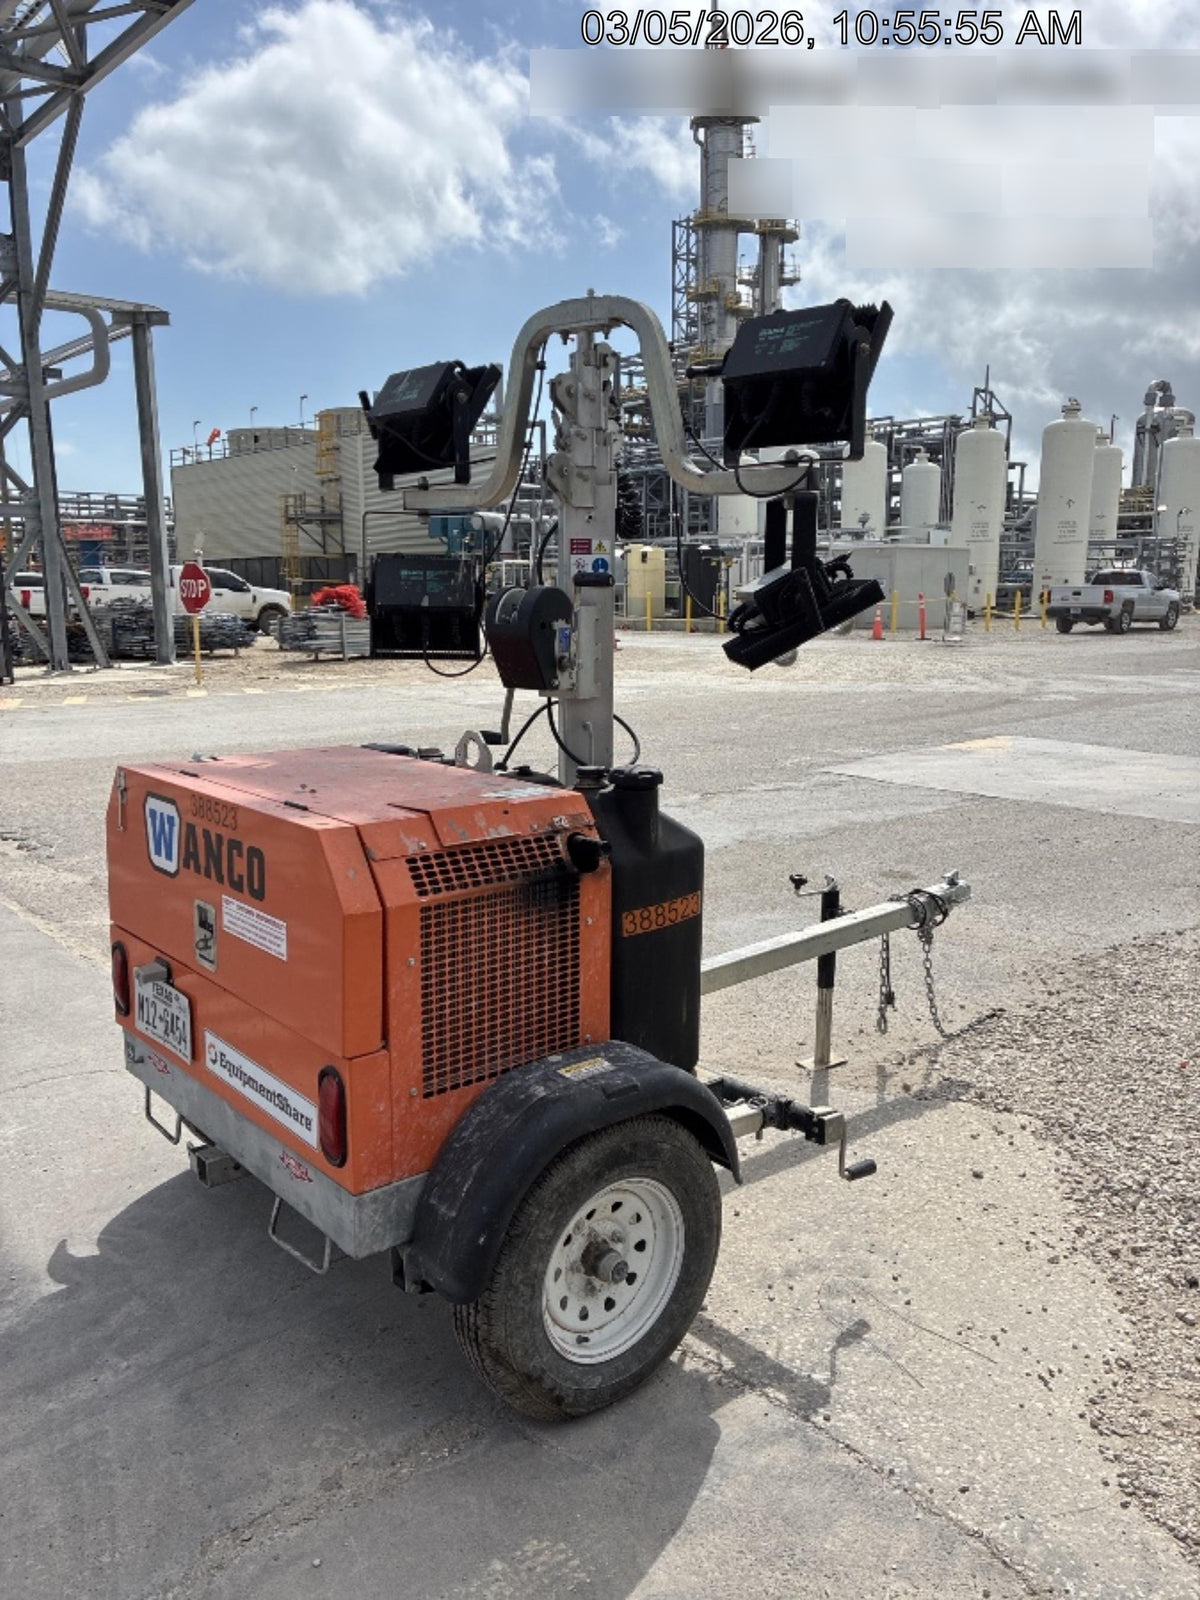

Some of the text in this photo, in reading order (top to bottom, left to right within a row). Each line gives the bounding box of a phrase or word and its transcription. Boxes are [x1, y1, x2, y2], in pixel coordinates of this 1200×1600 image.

[181, 579, 206, 598] STOP
[191, 794, 238, 831] 388523
[148, 807, 265, 901] WANCO
[624, 892, 700, 935] 388523
[152, 982, 174, 1004] TEXAS
[219, 1051, 313, 1132] EquipmentShare
